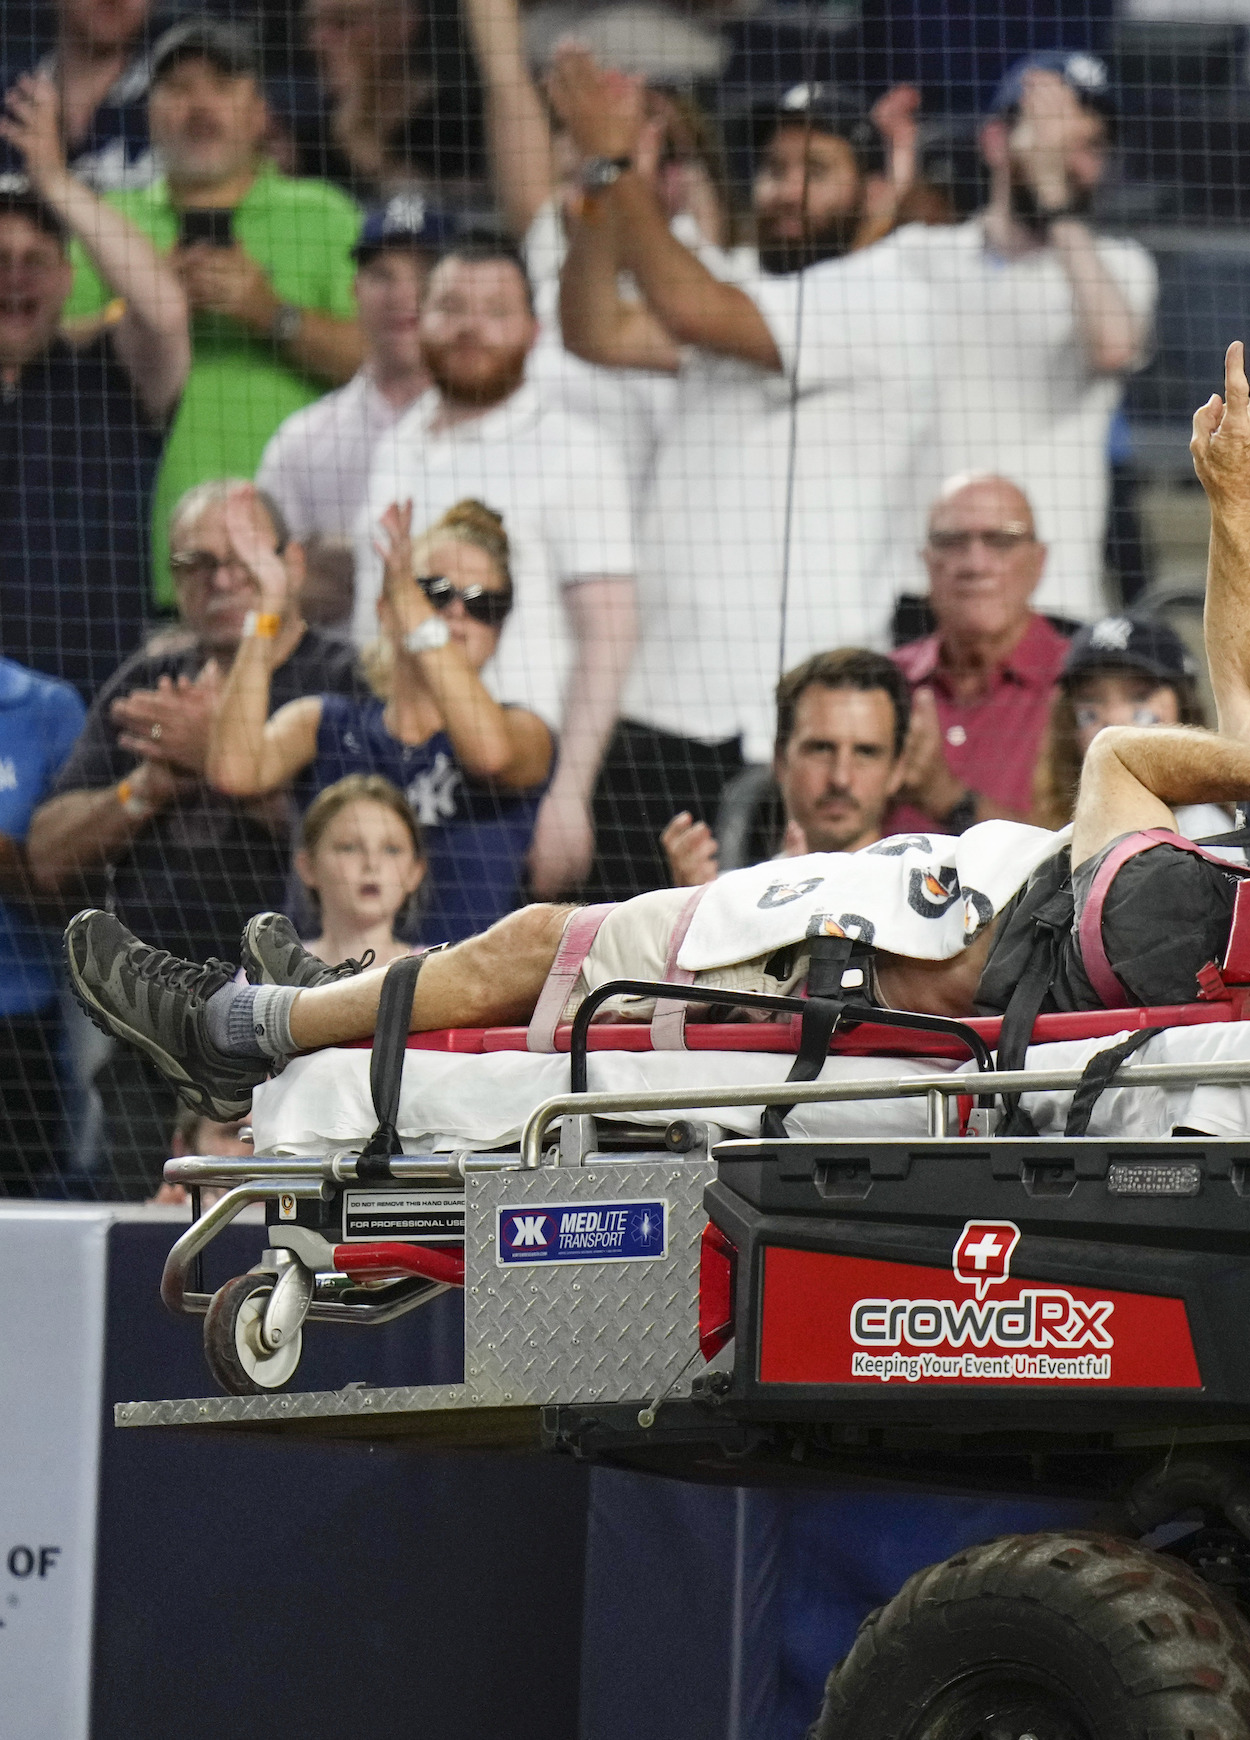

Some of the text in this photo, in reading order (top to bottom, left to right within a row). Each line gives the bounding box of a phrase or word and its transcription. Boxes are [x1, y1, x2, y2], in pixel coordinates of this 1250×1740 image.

[350, 1219, 465, 1228] FOR PROFESSIONAL USE
[559, 1210, 629, 1233] MEDLITE
[559, 1231, 626, 1249] TRANSPORT
[853, 1294, 1110, 1344] crowdRx
[854, 1354, 1109, 1378] Keeping Your Event UnEventful
[7, 1544, 62, 1579] OF
